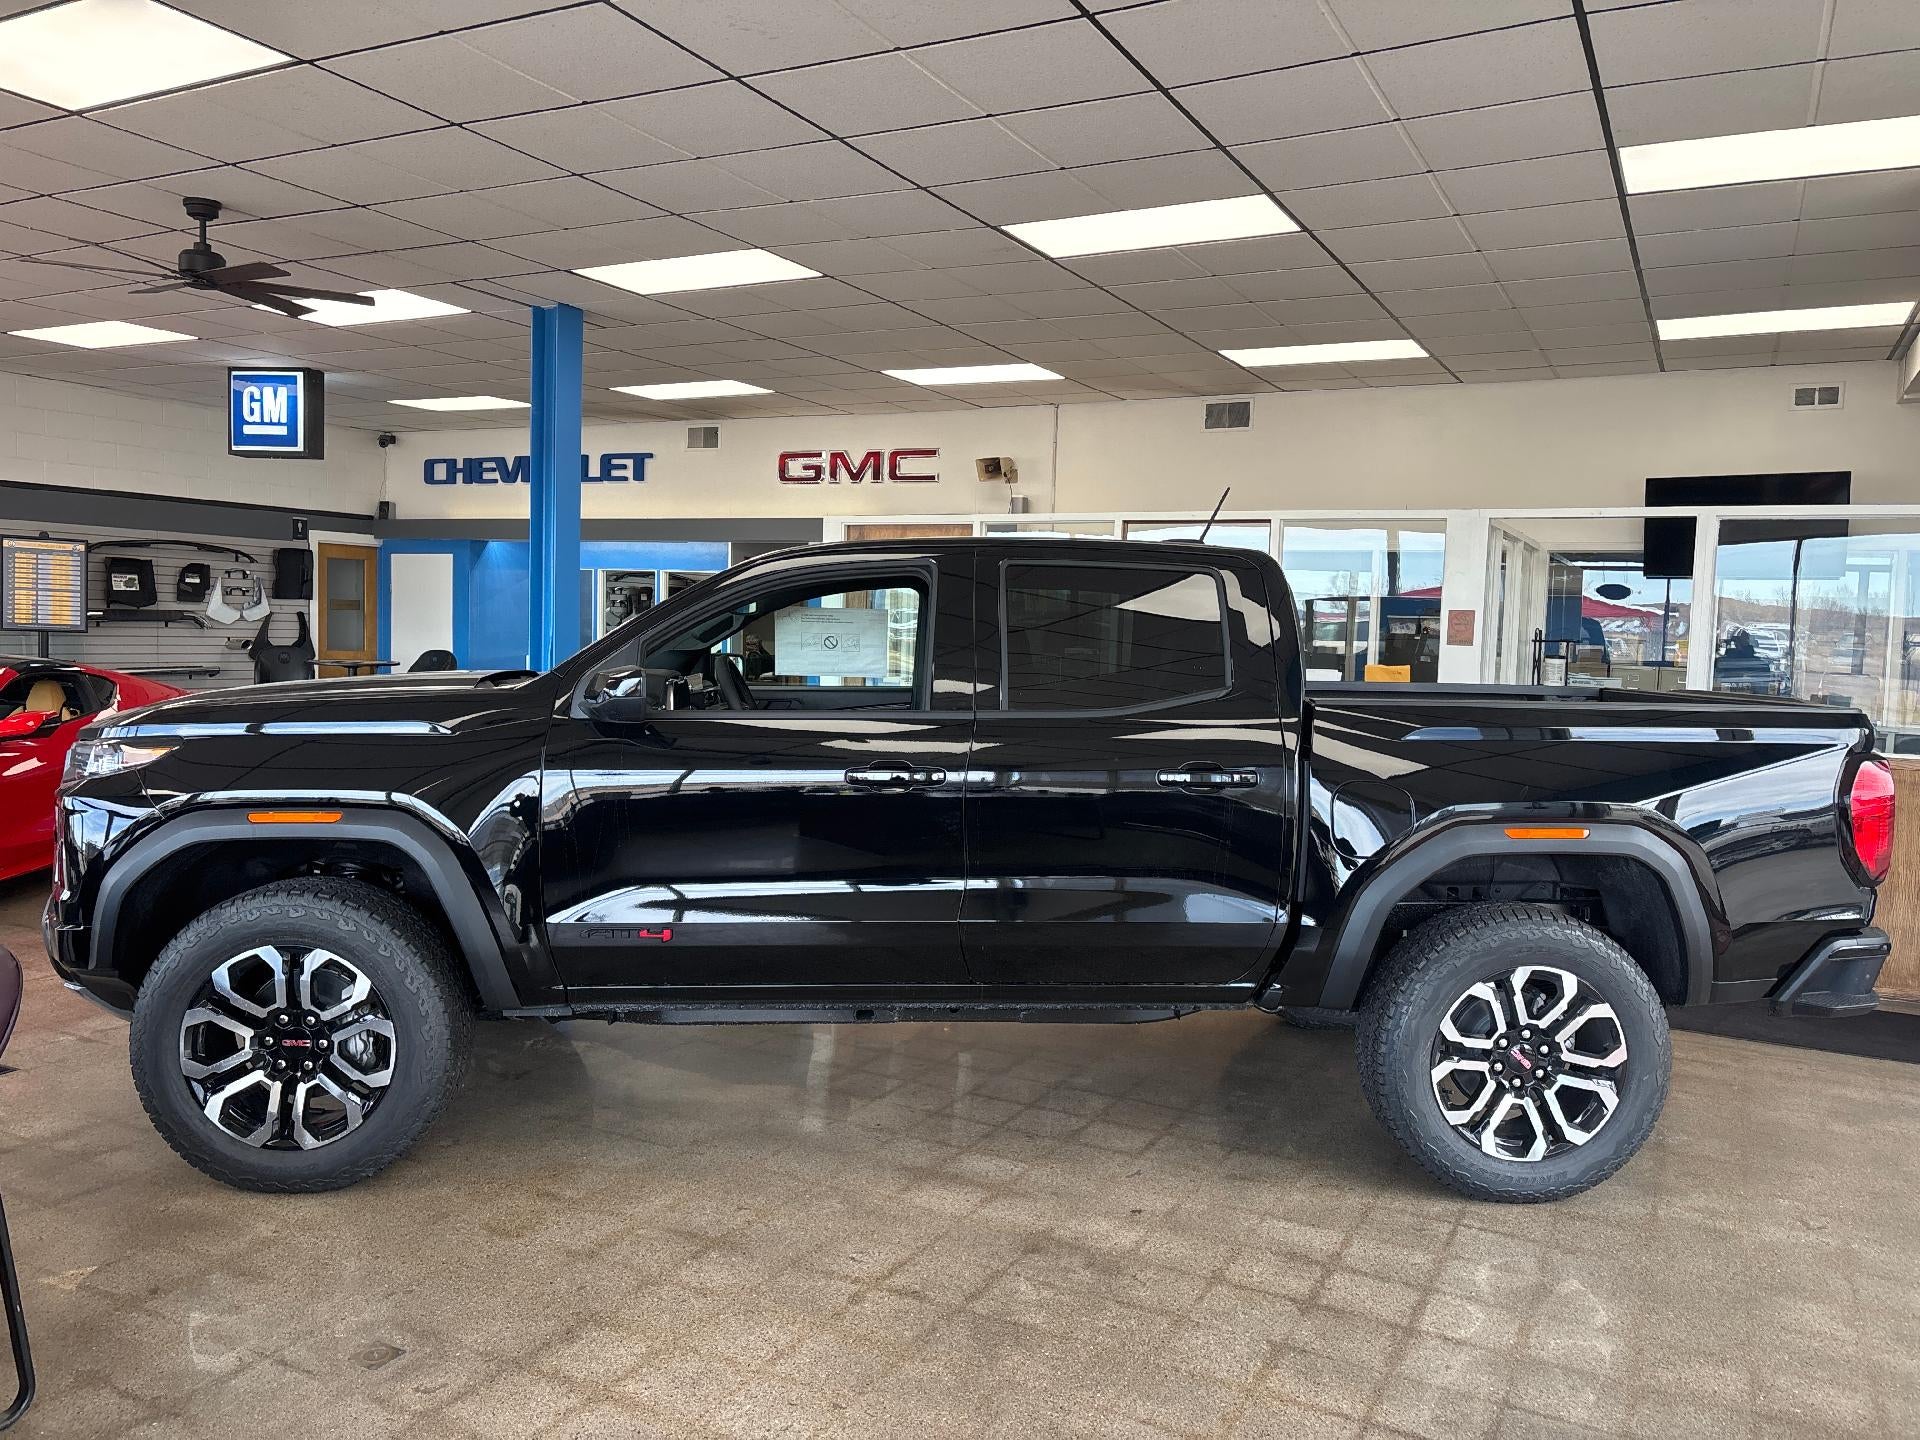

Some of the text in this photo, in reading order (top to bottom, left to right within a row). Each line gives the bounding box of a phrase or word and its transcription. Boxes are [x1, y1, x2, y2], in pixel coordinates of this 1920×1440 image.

[242, 385, 288, 423] GM
[424, 453, 654, 485] CHEVLET
[778, 448, 940, 484] GMC
[580, 926, 674, 943] AT4
[281, 1039, 311, 1047] GMC
